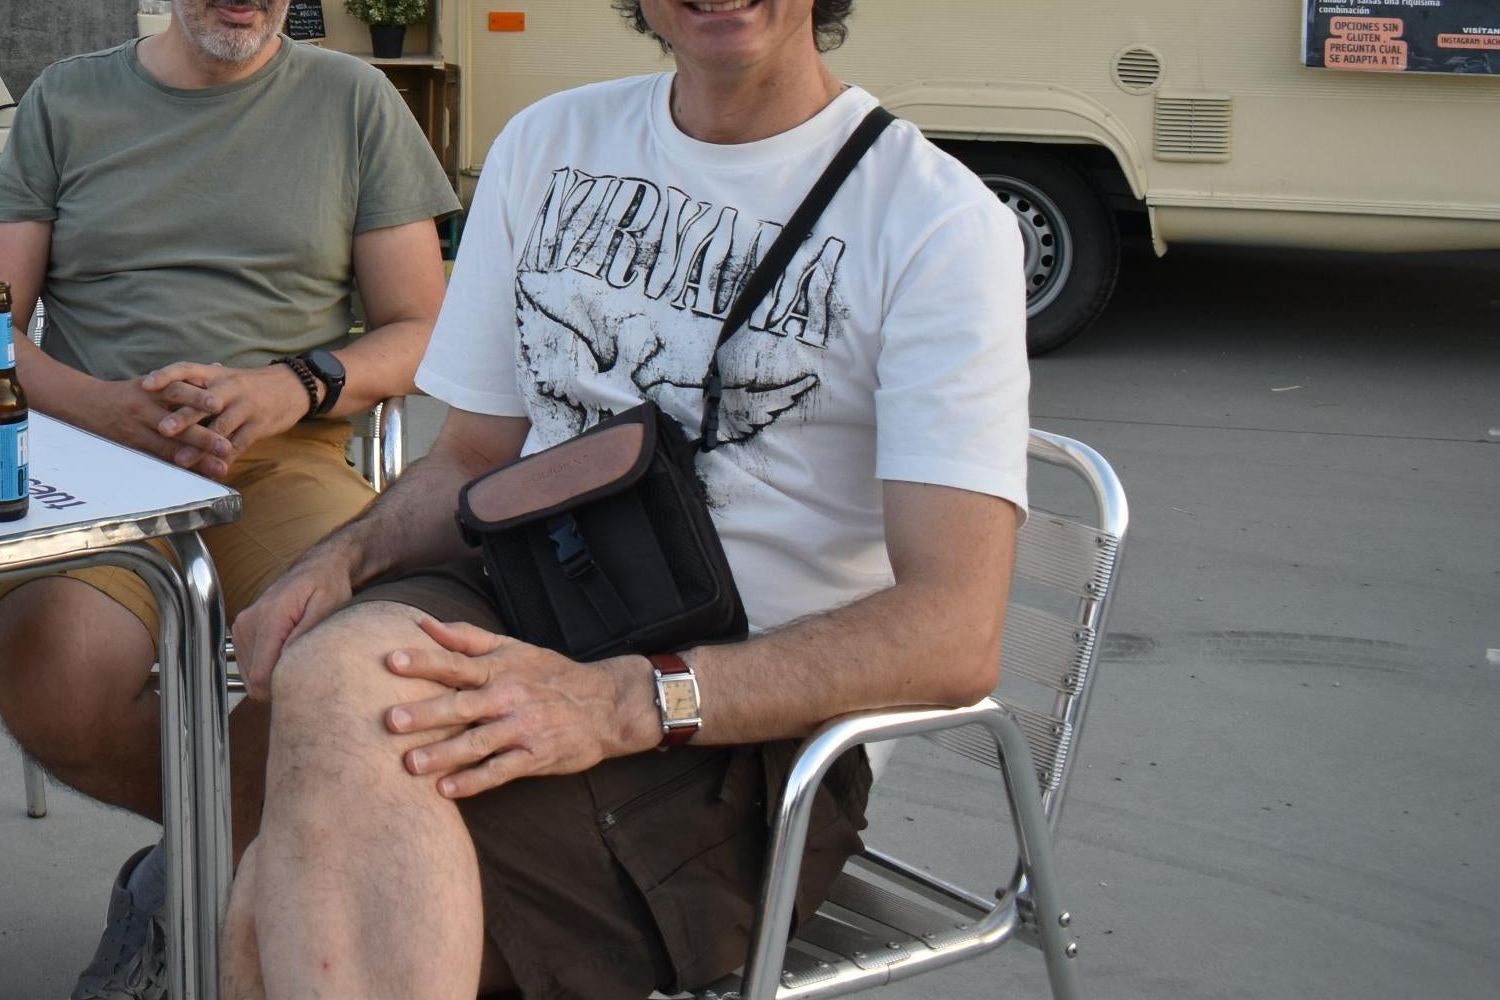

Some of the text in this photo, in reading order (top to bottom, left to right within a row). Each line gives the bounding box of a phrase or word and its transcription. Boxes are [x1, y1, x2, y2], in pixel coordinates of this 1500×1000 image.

[1319, 6, 1370, 15] combinación
[1335, 21, 1398, 32] OPCIONES SIN
[1347, 33, 1381, 42] GLUTEN
[1330, 43, 1402, 55] PREGUNTA CUAL
[1329, 54, 1387, 64] SE ADAPTA A
